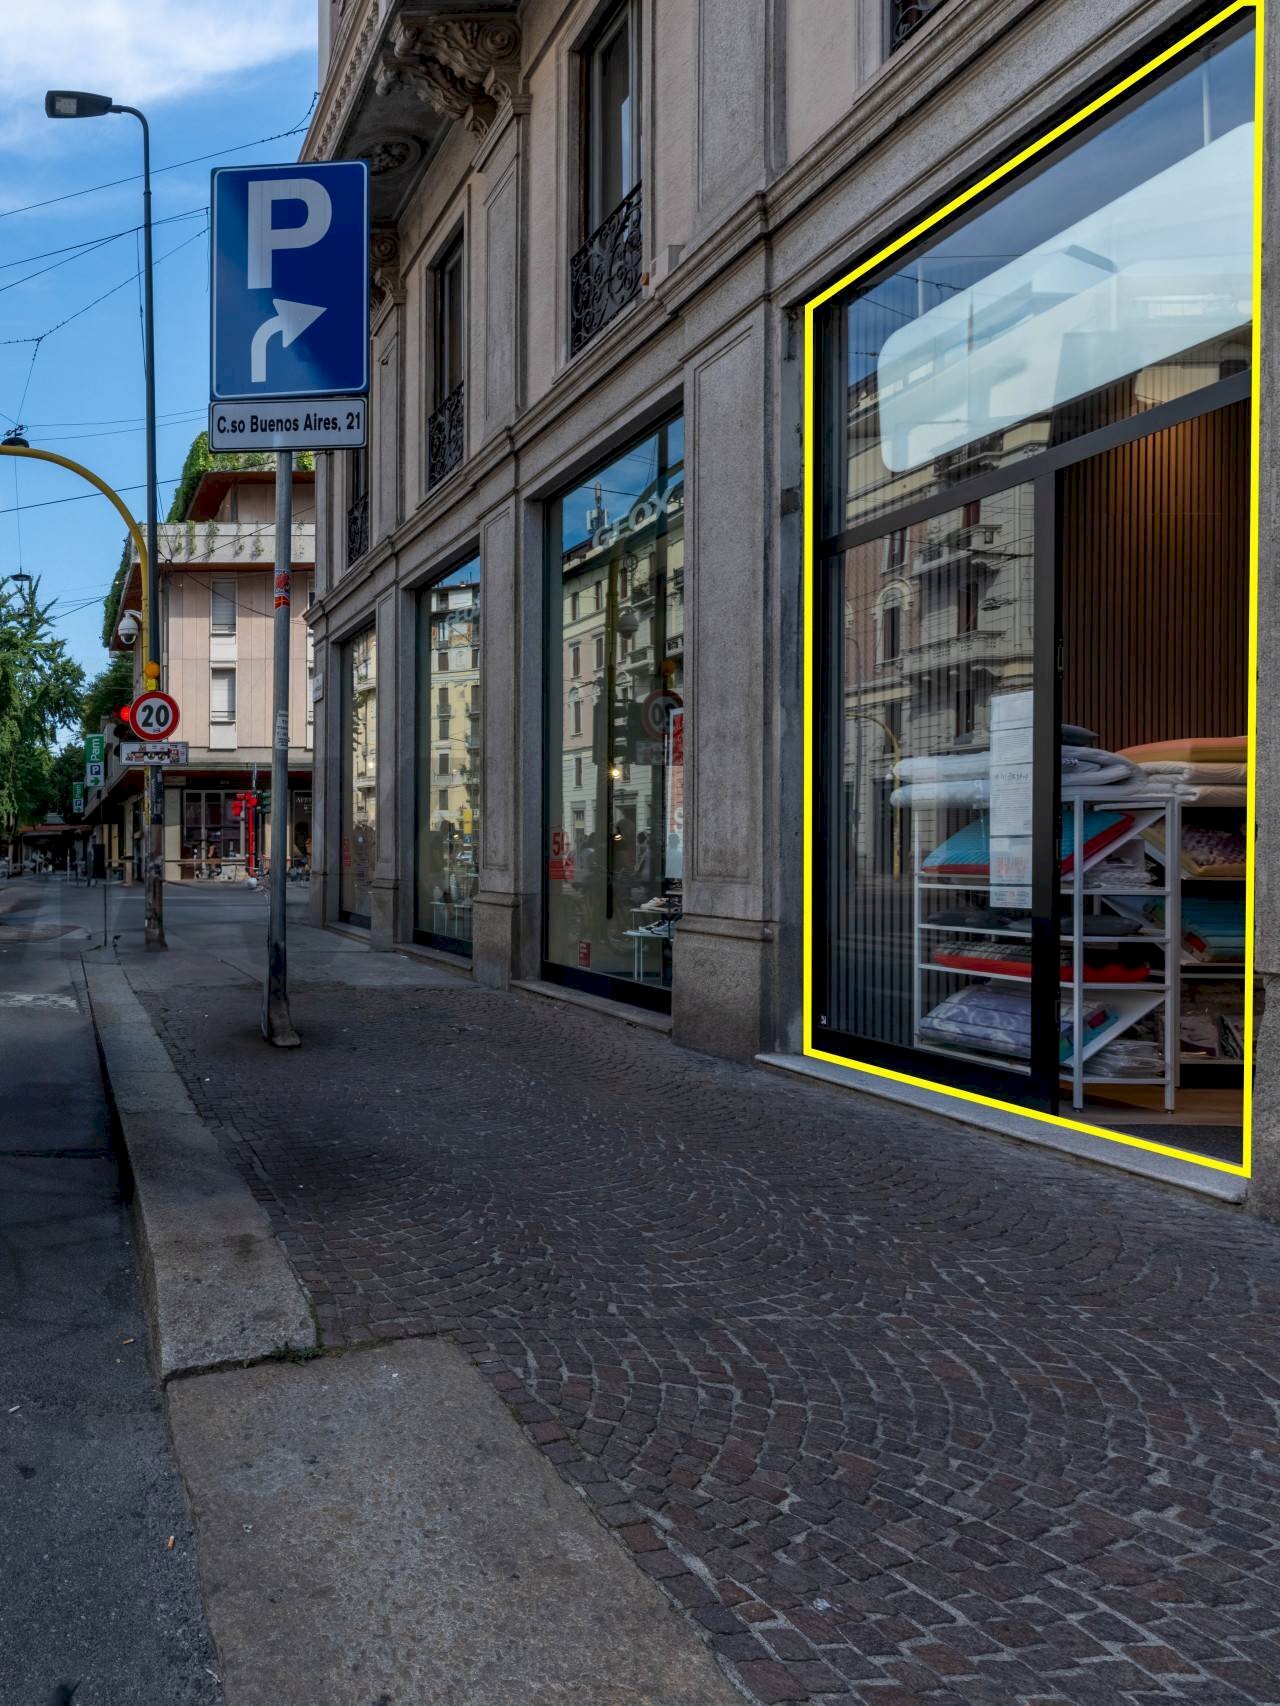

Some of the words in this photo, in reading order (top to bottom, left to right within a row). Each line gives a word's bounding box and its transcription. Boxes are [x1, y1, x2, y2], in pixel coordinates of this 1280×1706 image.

[247, 178, 332, 289] P
[217, 416, 246, 434] C.so
[250, 415, 300, 432] Buenos
[303, 413, 341, 432] Aires,
[346, 412, 361, 430] 21
[592, 486, 674, 549] GEOX
[141, 704, 170, 728] 20
[90, 738, 100, 761] Pam
